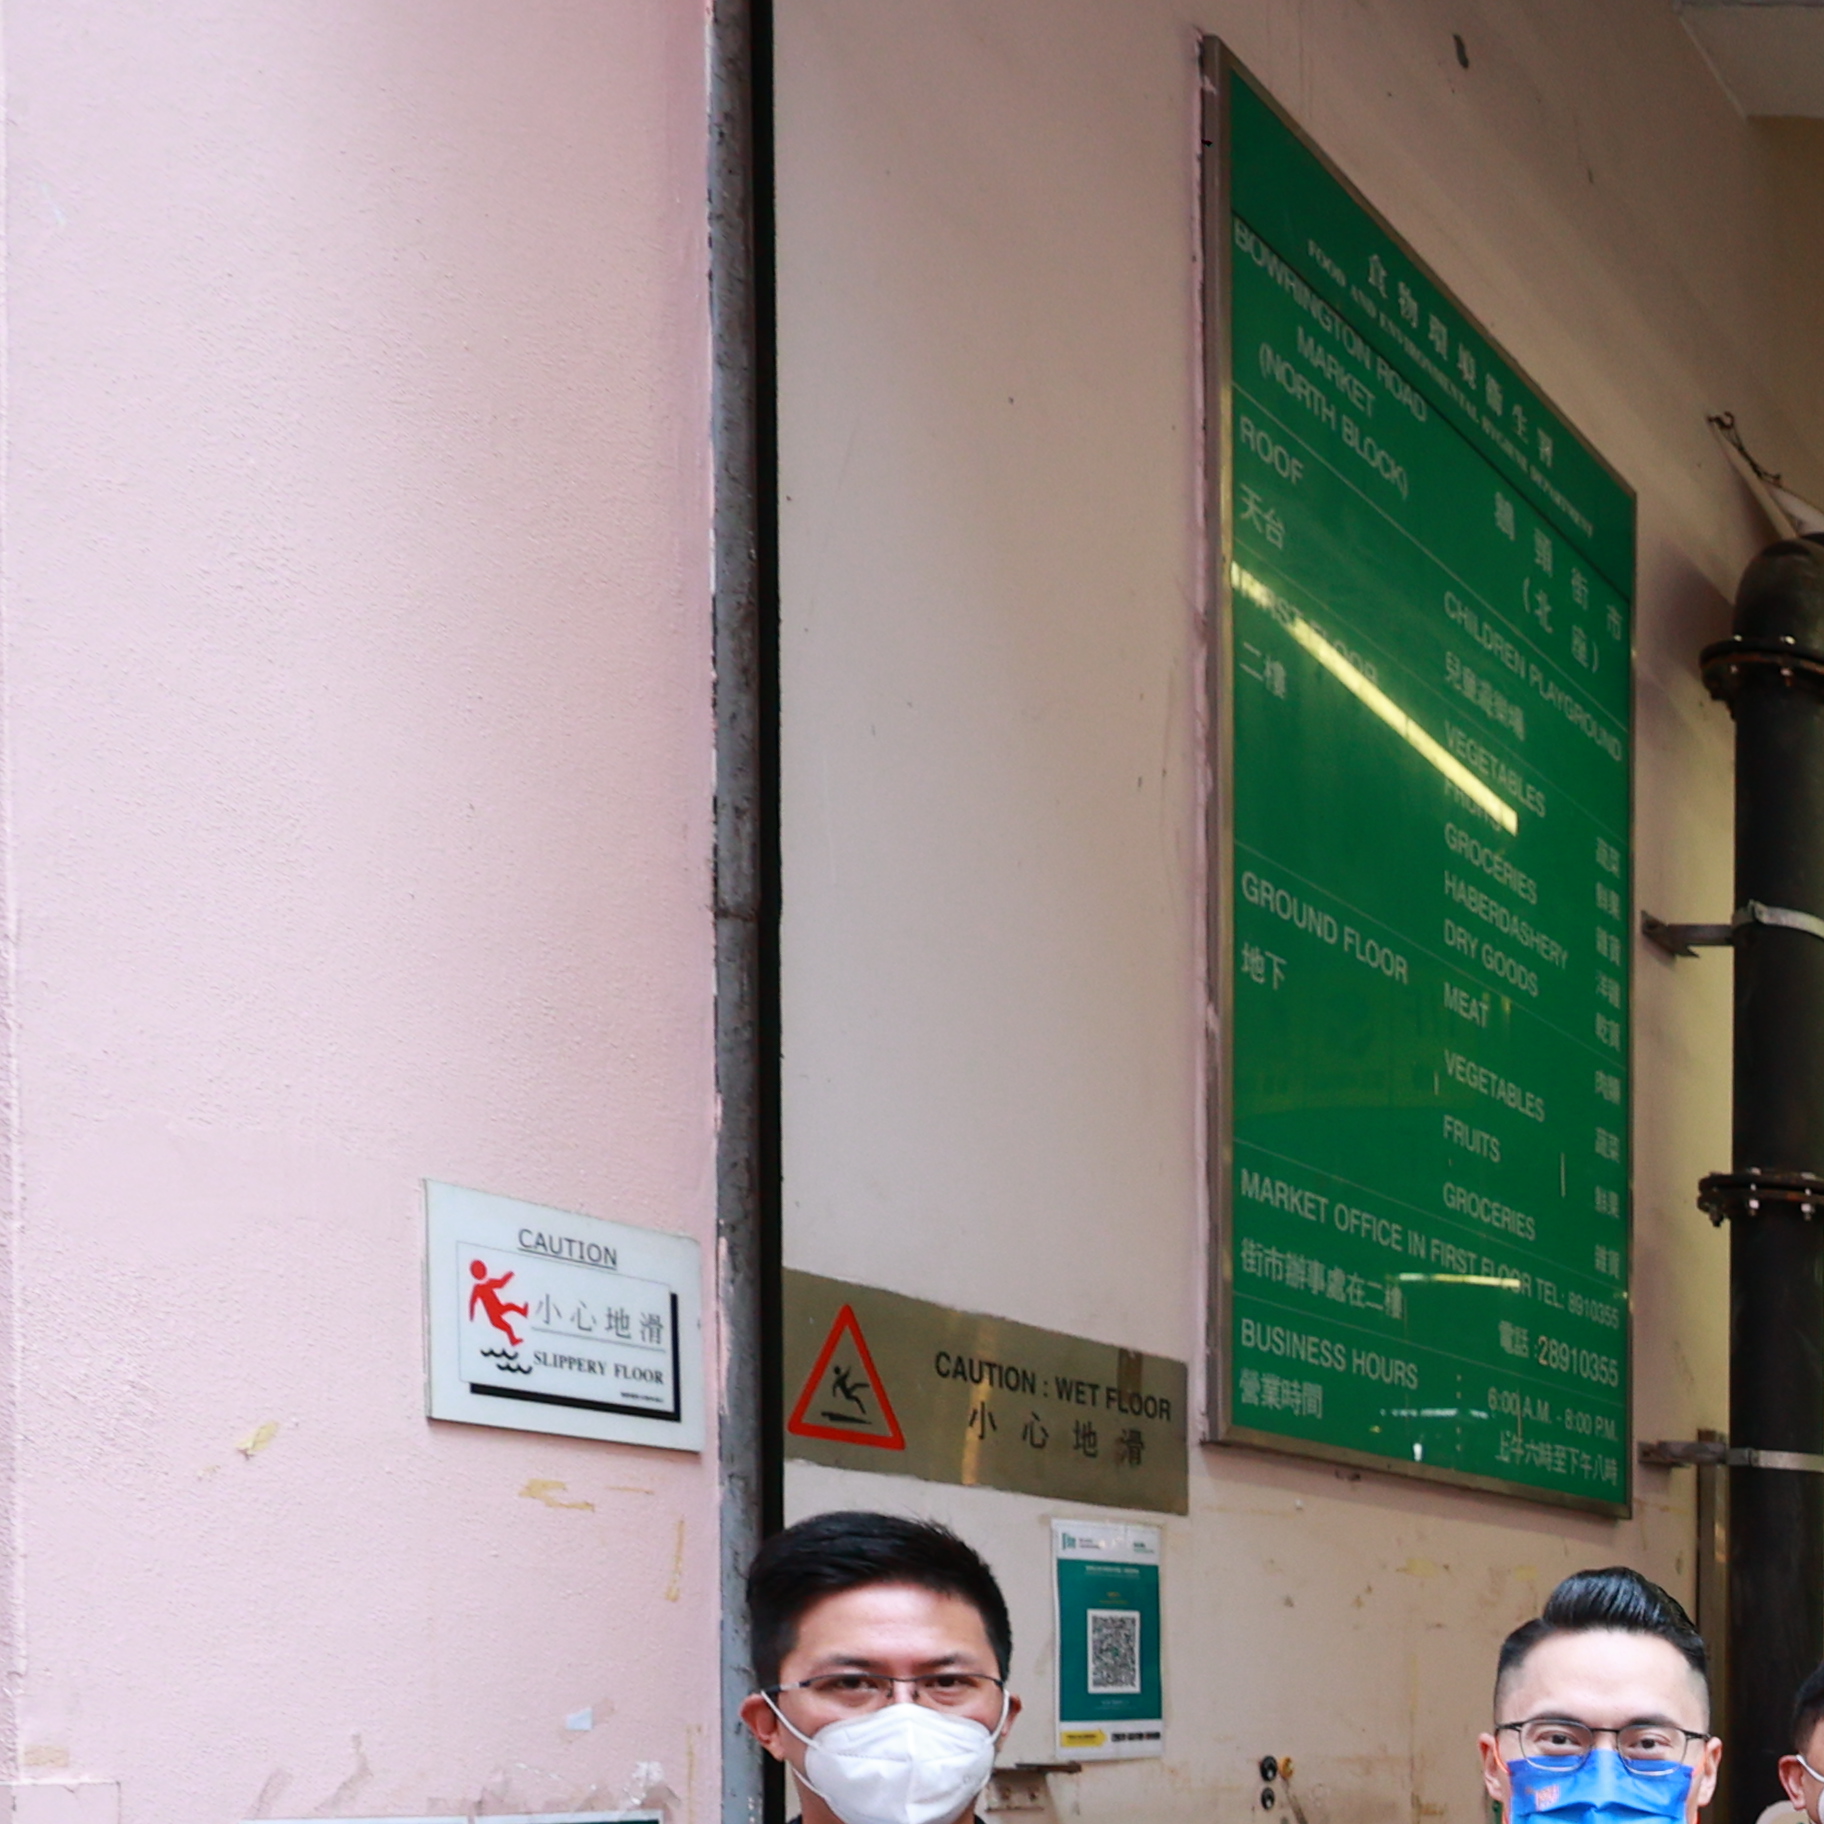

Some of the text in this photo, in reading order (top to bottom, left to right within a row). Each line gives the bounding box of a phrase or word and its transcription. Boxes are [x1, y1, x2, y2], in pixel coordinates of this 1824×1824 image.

[1309, 239, 1347, 287] FOOD
[1233, 217, 1428, 422] BOWRINGTON ROAD
[1297, 326, 1376, 419] MARKET
[1239, 415, 1303, 485] ROOF
[1259, 342, 1409, 501] (NORTH BLOCK)
[1239, 482, 1285, 550] 天台
[1443, 590, 1622, 762] CHILDREN PLAYGROUND
[1444, 719, 1546, 818] VEGETABLES
[1444, 822, 1538, 905] GROCERIES
[1240, 871, 1409, 987] GROUND FLOOR
[1444, 870, 1569, 970] HABERDASHERY
[1240, 943, 1287, 991] 地下
[1444, 918, 1540, 998] DRY GOODS
[1444, 981, 1489, 1029] MEAT
[1444, 1049, 1546, 1122] VEGETABLES
[1443, 1114, 1501, 1164] FRUITS
[517, 1227, 619, 1266] CAUTION
[1443, 1181, 1537, 1242] GROCERIES
[1240, 1168, 1329, 1225] MARKET
[1333, 1203, 1402, 1252] OFFICE
[1407, 1230, 1427, 1260] IN
[1430, 1238, 1478, 1276] FIRST
[1568, 1293, 1620, 1330] 8910355
[535, 1293, 665, 1345] 小心地滑
[1240, 1317, 1419, 1390] BUSINESS HOURS
[532, 1350, 664, 1385] SLIPPERY FLOOR
[935, 1351, 1172, 1422] CAUTION WET FLOOR
[1239, 1367, 1323, 1419] 營業時間
[968, 1401, 1146, 1467] 小心地滑
[1487, 1387, 1519, 1417] 6:00
[1564, 1405, 1593, 1435] 8:00
